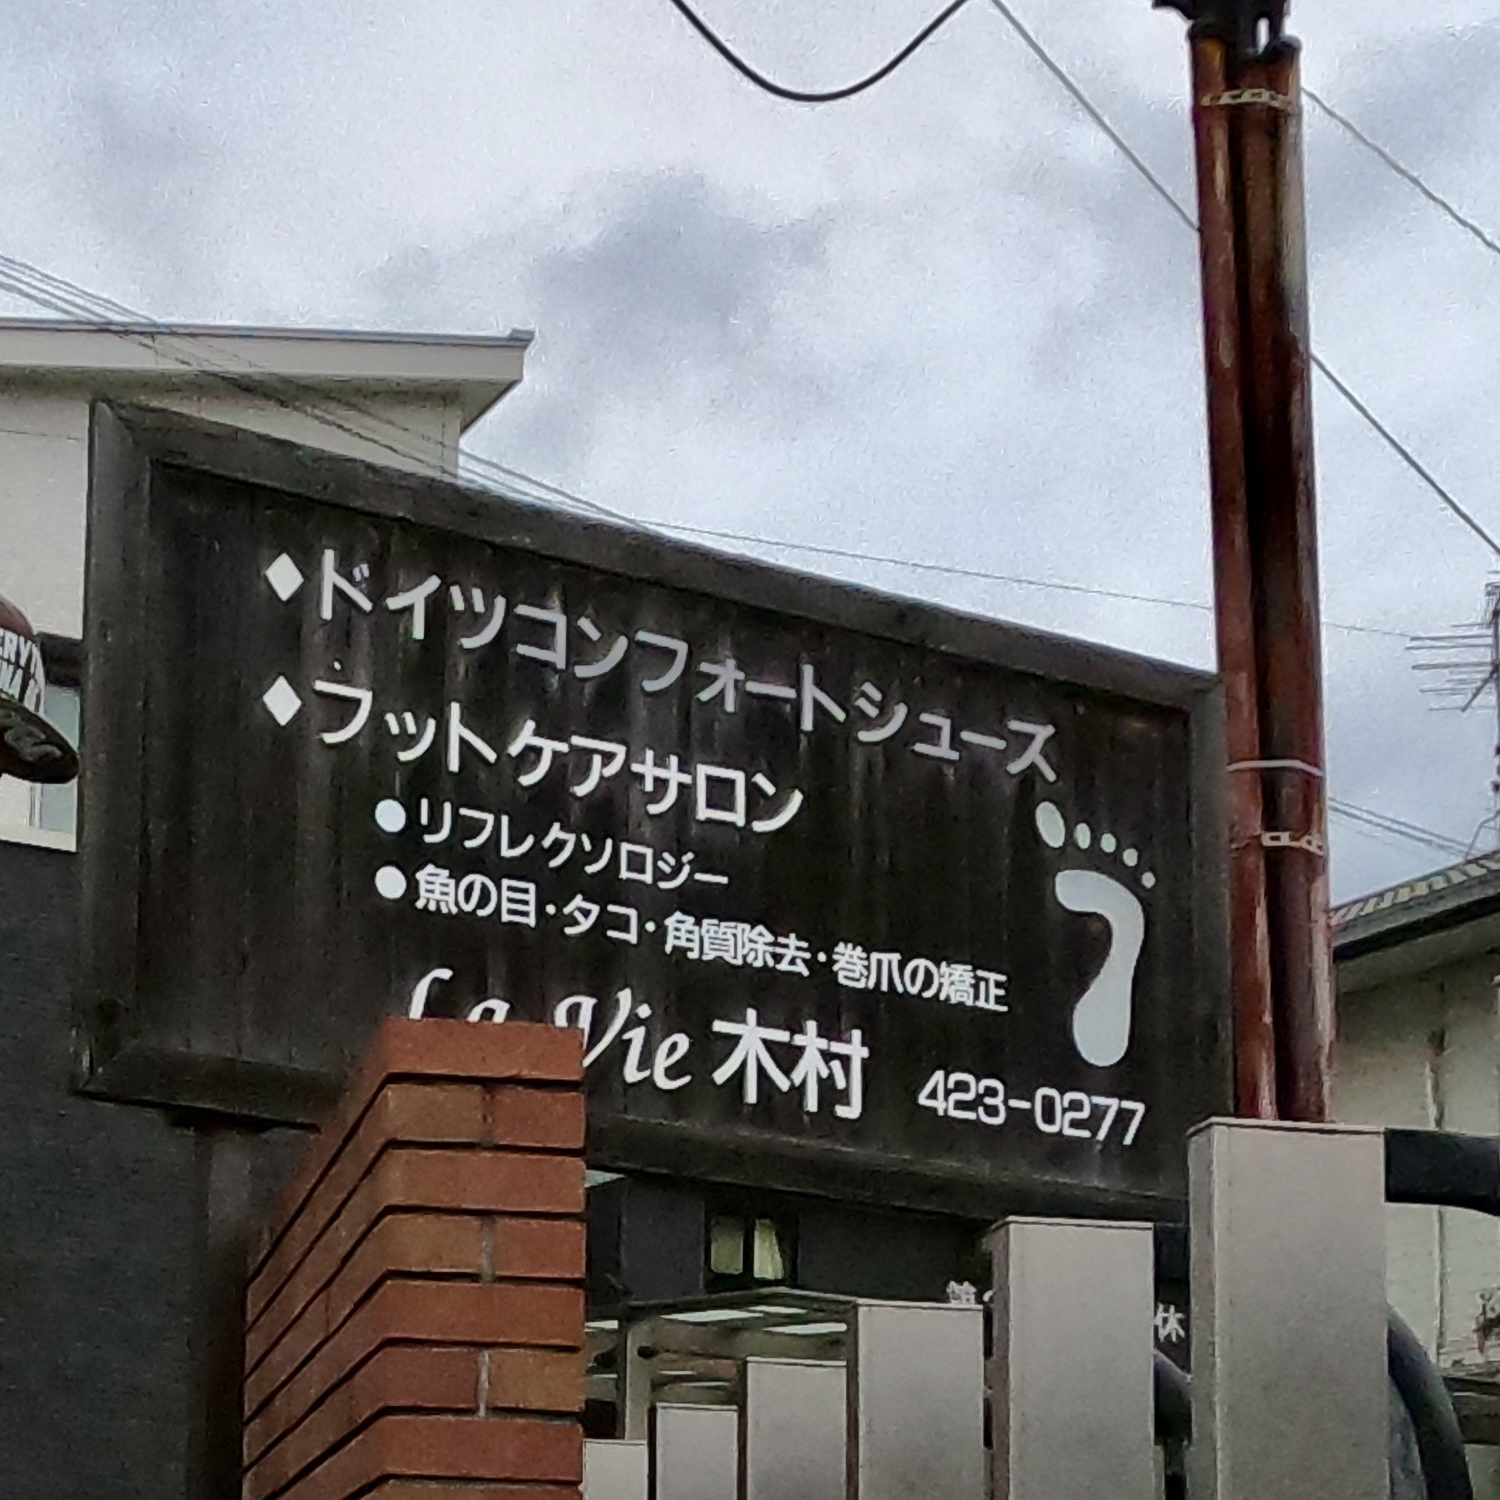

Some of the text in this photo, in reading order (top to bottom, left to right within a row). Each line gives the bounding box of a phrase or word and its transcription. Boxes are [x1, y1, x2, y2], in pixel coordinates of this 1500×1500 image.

[313, 679, 803, 833] フットケアサロン
[419, 798, 729, 890] リフレクソロジー
[554, 988, 692, 1090] Vie
[712, 1007, 869, 1119] 木村
[917, 1069, 1146, 1145] 423-0277
